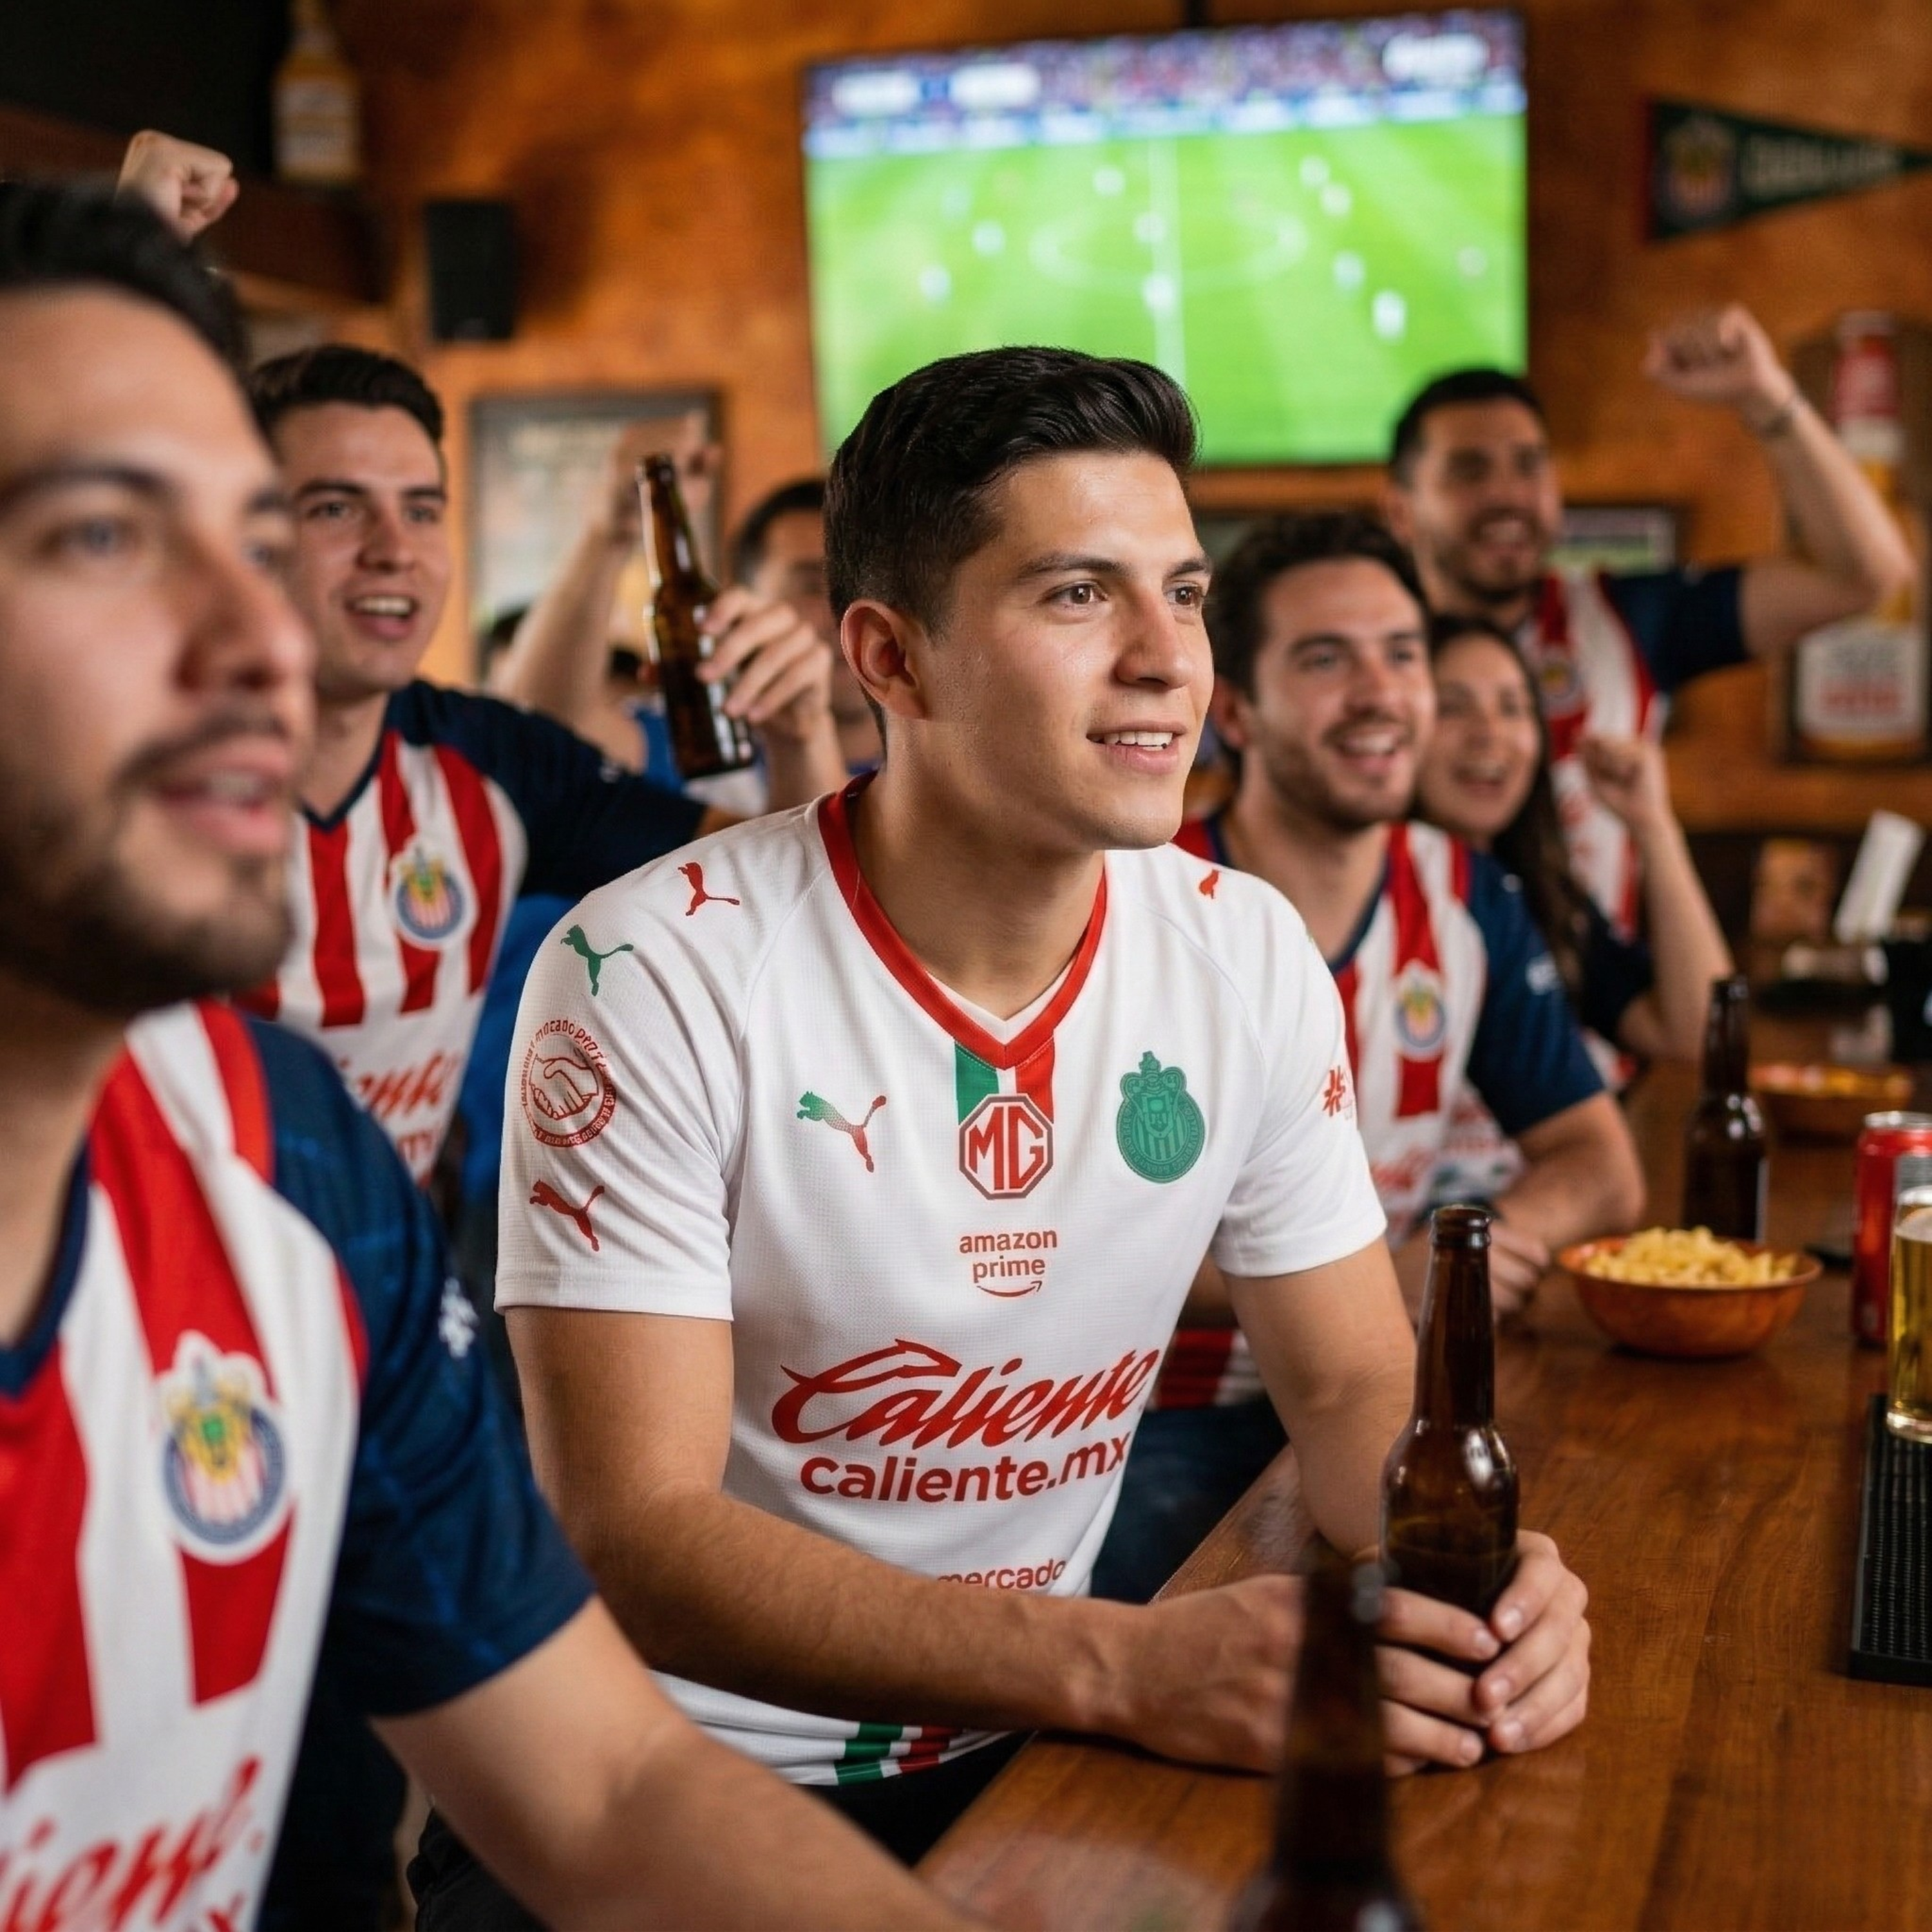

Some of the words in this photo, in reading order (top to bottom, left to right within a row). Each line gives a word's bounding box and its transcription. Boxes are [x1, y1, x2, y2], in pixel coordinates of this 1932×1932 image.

[969, 1105, 1045, 1191] MG
[960, 1229, 1057, 1253] amazon
[972, 1255, 1046, 1283] prime
[772, 1339, 1159, 1449] Caliente
[800, 1432, 1131, 1502] caliente.mx
